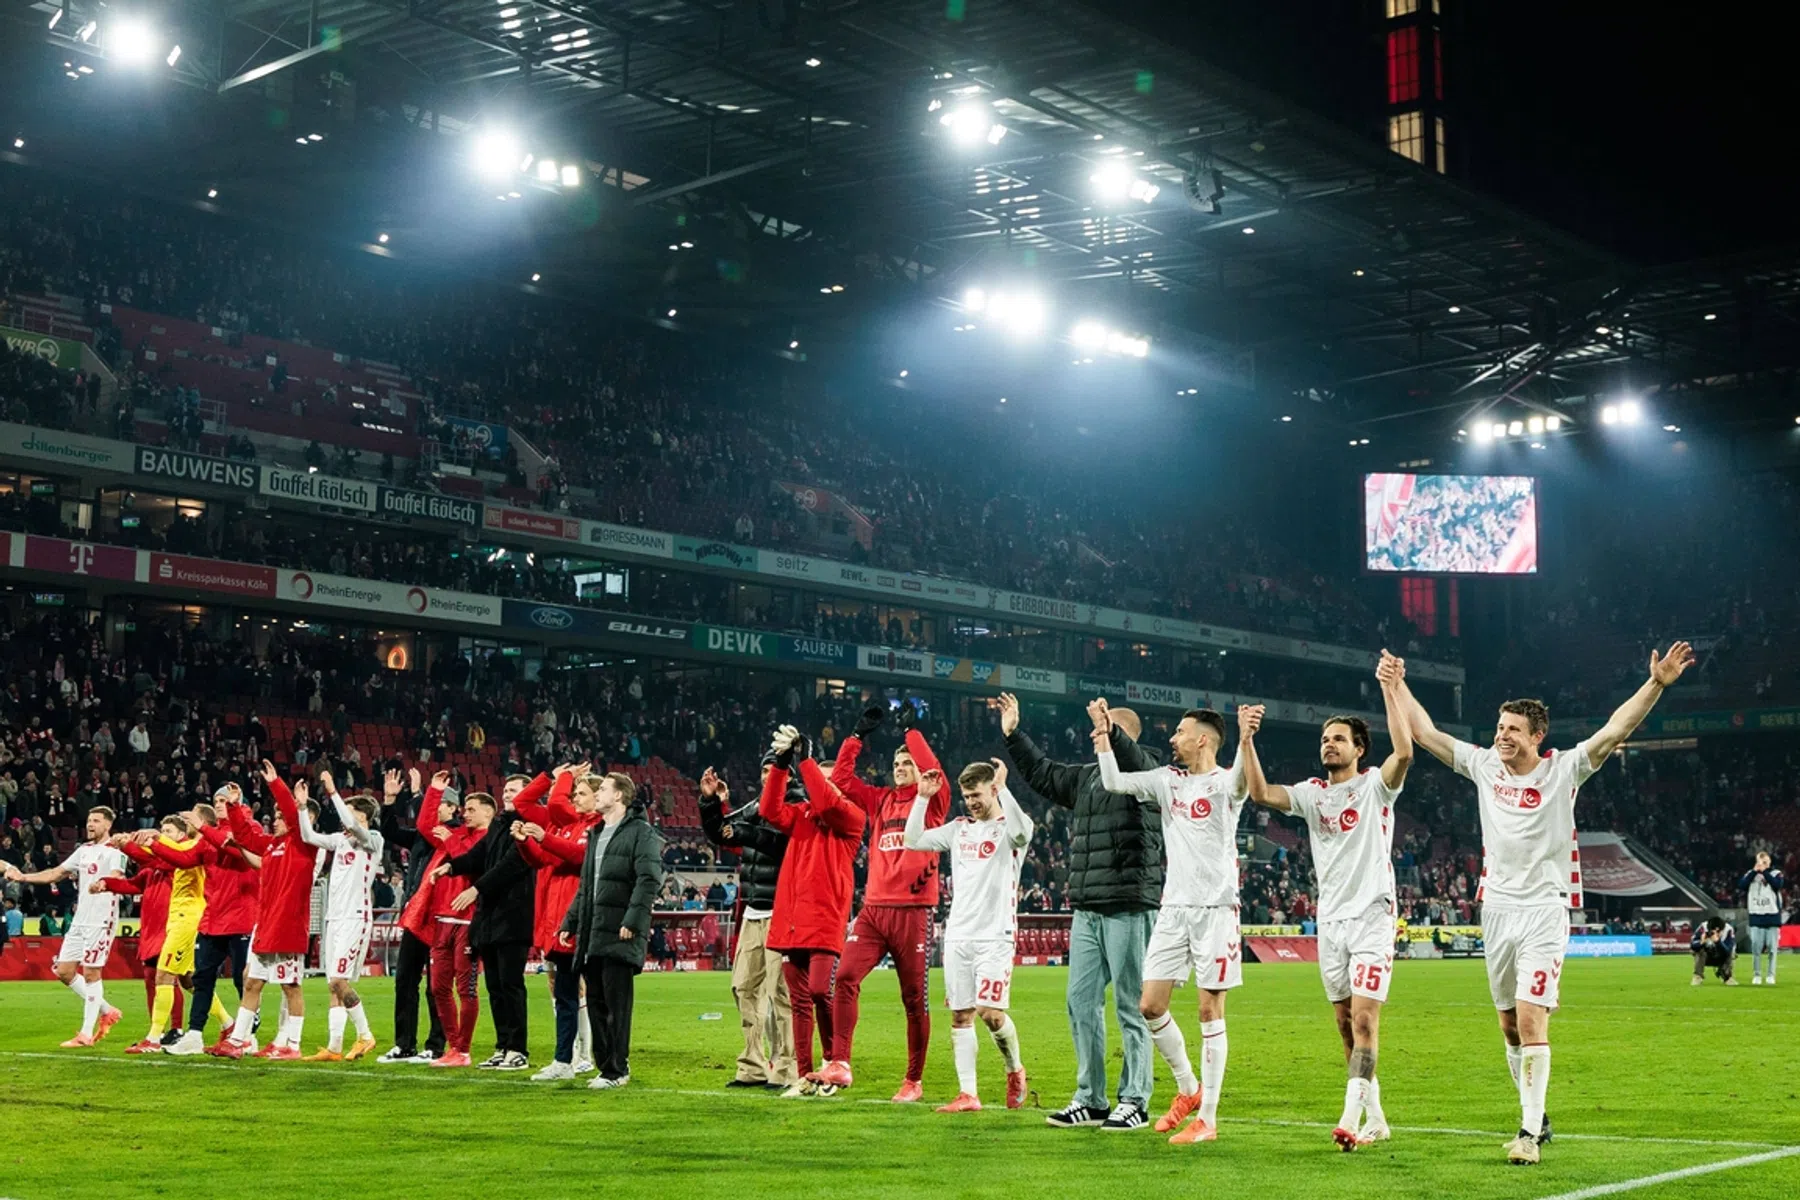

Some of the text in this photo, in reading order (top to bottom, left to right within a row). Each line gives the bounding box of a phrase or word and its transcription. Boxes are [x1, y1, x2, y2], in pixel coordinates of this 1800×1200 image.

[141, 451, 255, 488] BAUWENS
[269, 470, 368, 508] Gaffel Kölsch
[384, 490, 427, 516] Gaffel
[428, 500, 476, 525] Kölsch
[602, 528, 666, 550] GRIESEMANN
[776, 555, 809, 572] seitz
[176, 570, 246, 588] Kreissparkasse
[247, 573, 268, 591] Köln
[316, 583, 382, 602] RheinEnergie
[430, 597, 491, 616] RheinEnergie
[538, 610, 565, 627] Ford
[608, 621, 687, 639] BULLS
[708, 629, 763, 656] DEVK
[793, 638, 844, 658] SAUREN
[934, 657, 954, 676] SAP
[972, 664, 992, 679] SAP
[1015, 665, 1052, 684] Dorint
[1142, 687, 1182, 705] OSMAB
[880, 834, 905, 849] REW
[84, 949, 99, 964] 27
[165, 952, 173, 967] 1
[337, 957, 348, 974] 8
[276, 964, 286, 980] 9
[1215, 957, 1229, 983] 7
[1353, 963, 1383, 992] 35
[978, 978, 1004, 1002] 29
[1530, 970, 1548, 997] 3
